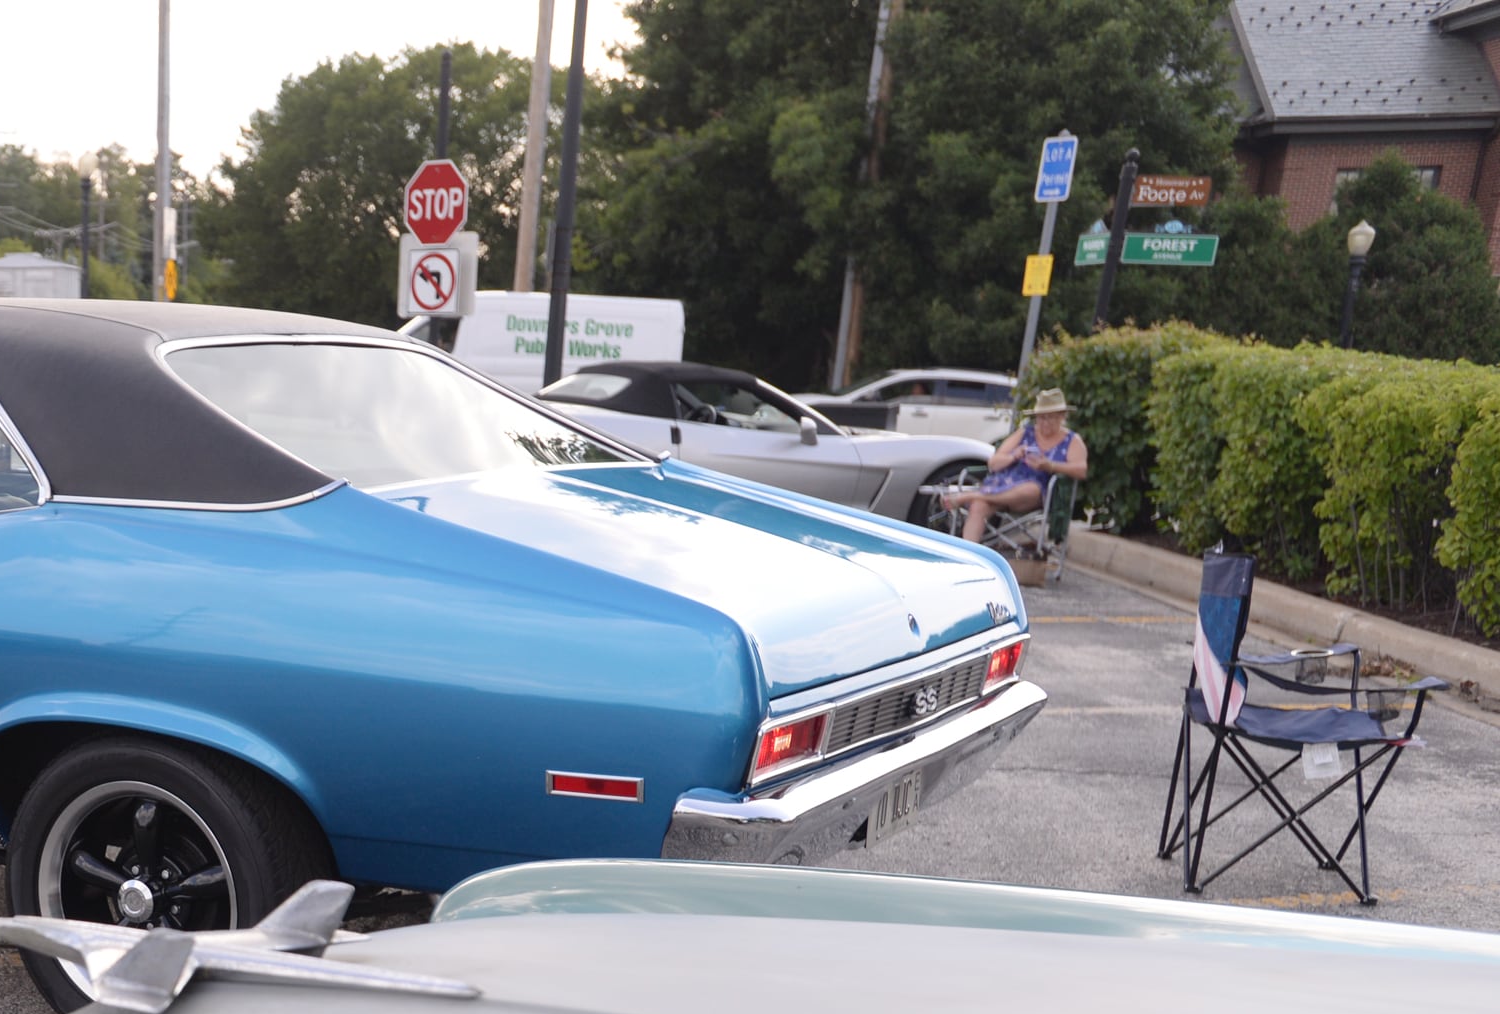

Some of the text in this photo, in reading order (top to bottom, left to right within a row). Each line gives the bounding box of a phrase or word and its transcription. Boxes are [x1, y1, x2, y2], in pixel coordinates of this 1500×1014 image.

[409, 186, 464, 221] STOP
[1137, 184, 1205, 203] Foote Av
[1142, 238, 1198, 252] FOREST
[506, 314, 634, 338] Downs Grove
[514, 336, 621, 359] Pub Works
[915, 685, 938, 715] SS
